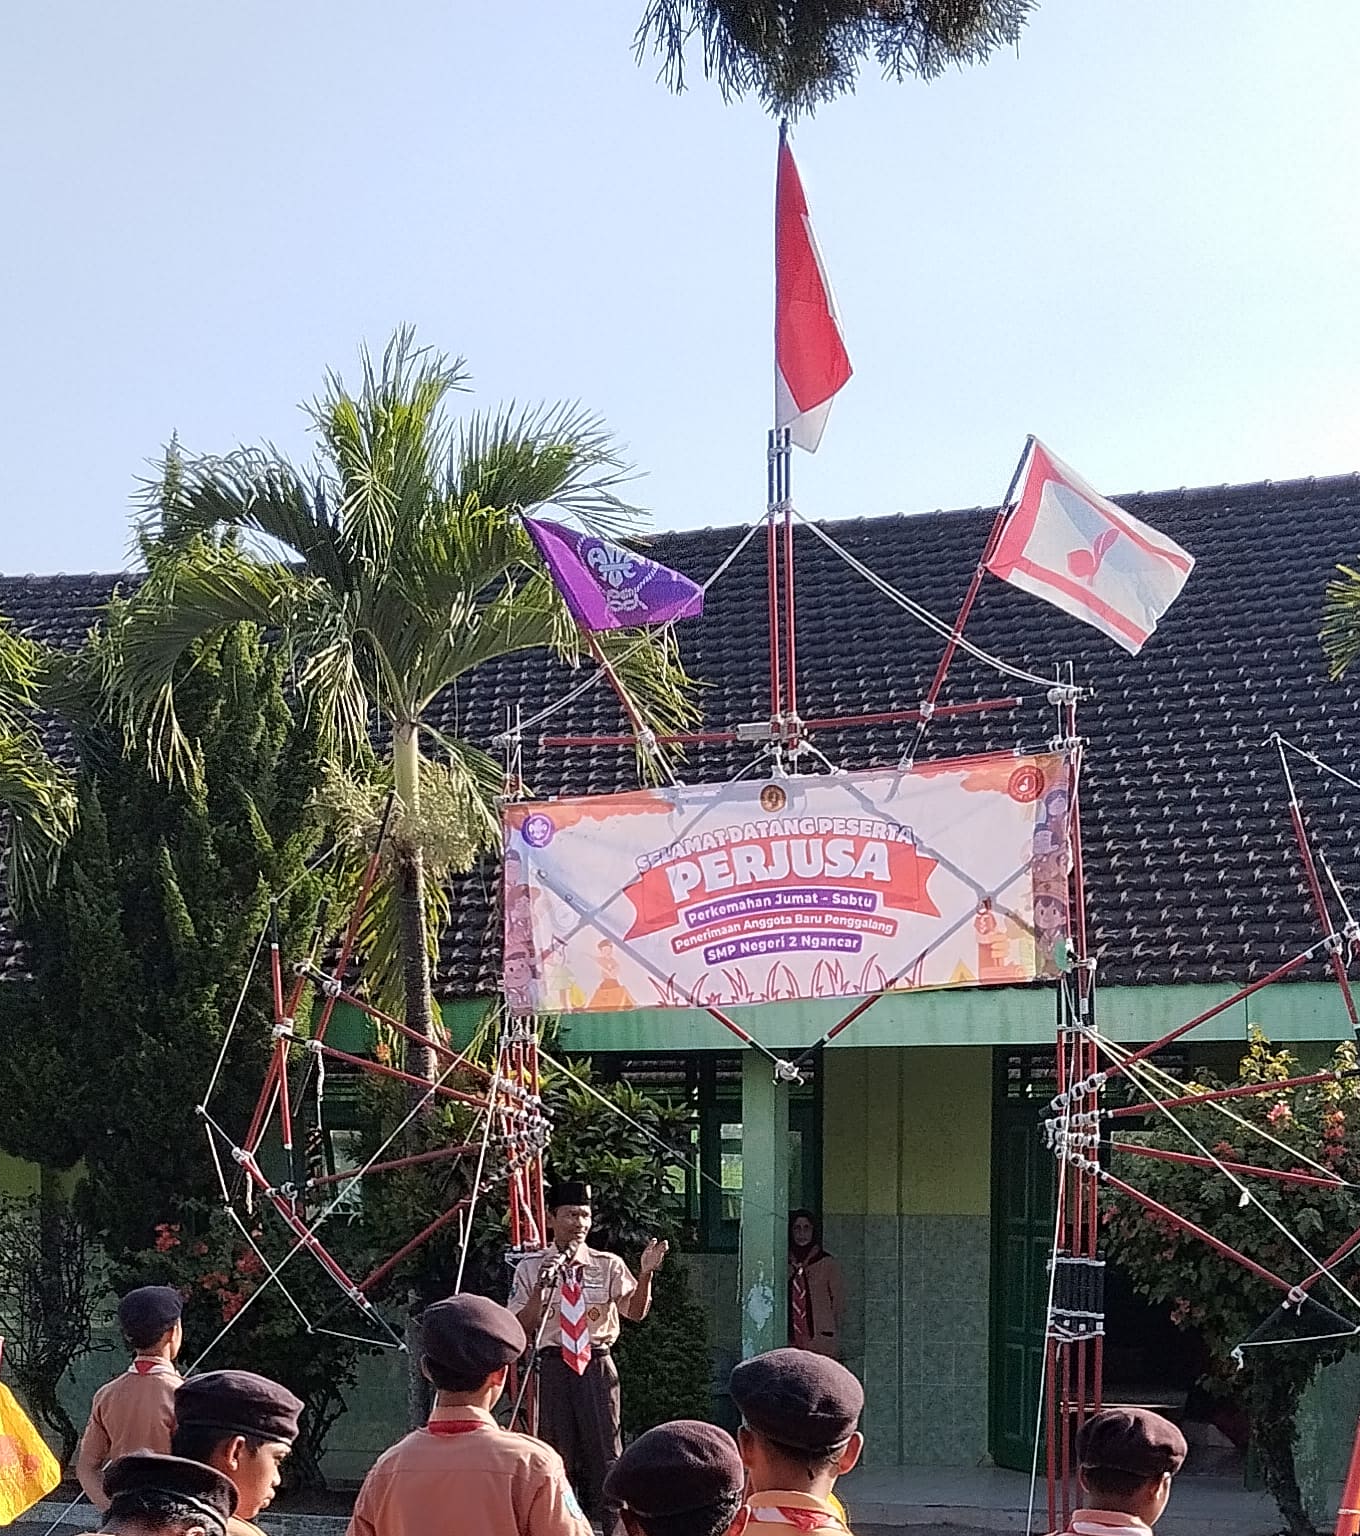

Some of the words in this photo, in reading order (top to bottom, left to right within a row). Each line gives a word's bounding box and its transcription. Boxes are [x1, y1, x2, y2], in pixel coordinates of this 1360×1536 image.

[636, 828, 726, 873] SELAMAT
[727, 819, 816, 843] DATANG
[818, 817, 913, 844] PESERTA
[666, 839, 891, 903] PERJUSA
[688, 896, 771, 923] Perkemahan
[774, 892, 818, 905] Jumat
[832, 893, 872, 908] Sabtu
[675, 924, 741, 950] Penerimaan
[744, 916, 791, 932] Anggota
[794, 914, 822, 925] Baru
[824, 914, 893, 934] Penggalang
[707, 945, 736, 962] SMP
[740, 937, 785, 954] Negeri
[789, 935, 797, 947] 2
[801, 934, 858, 951] Ngancar
